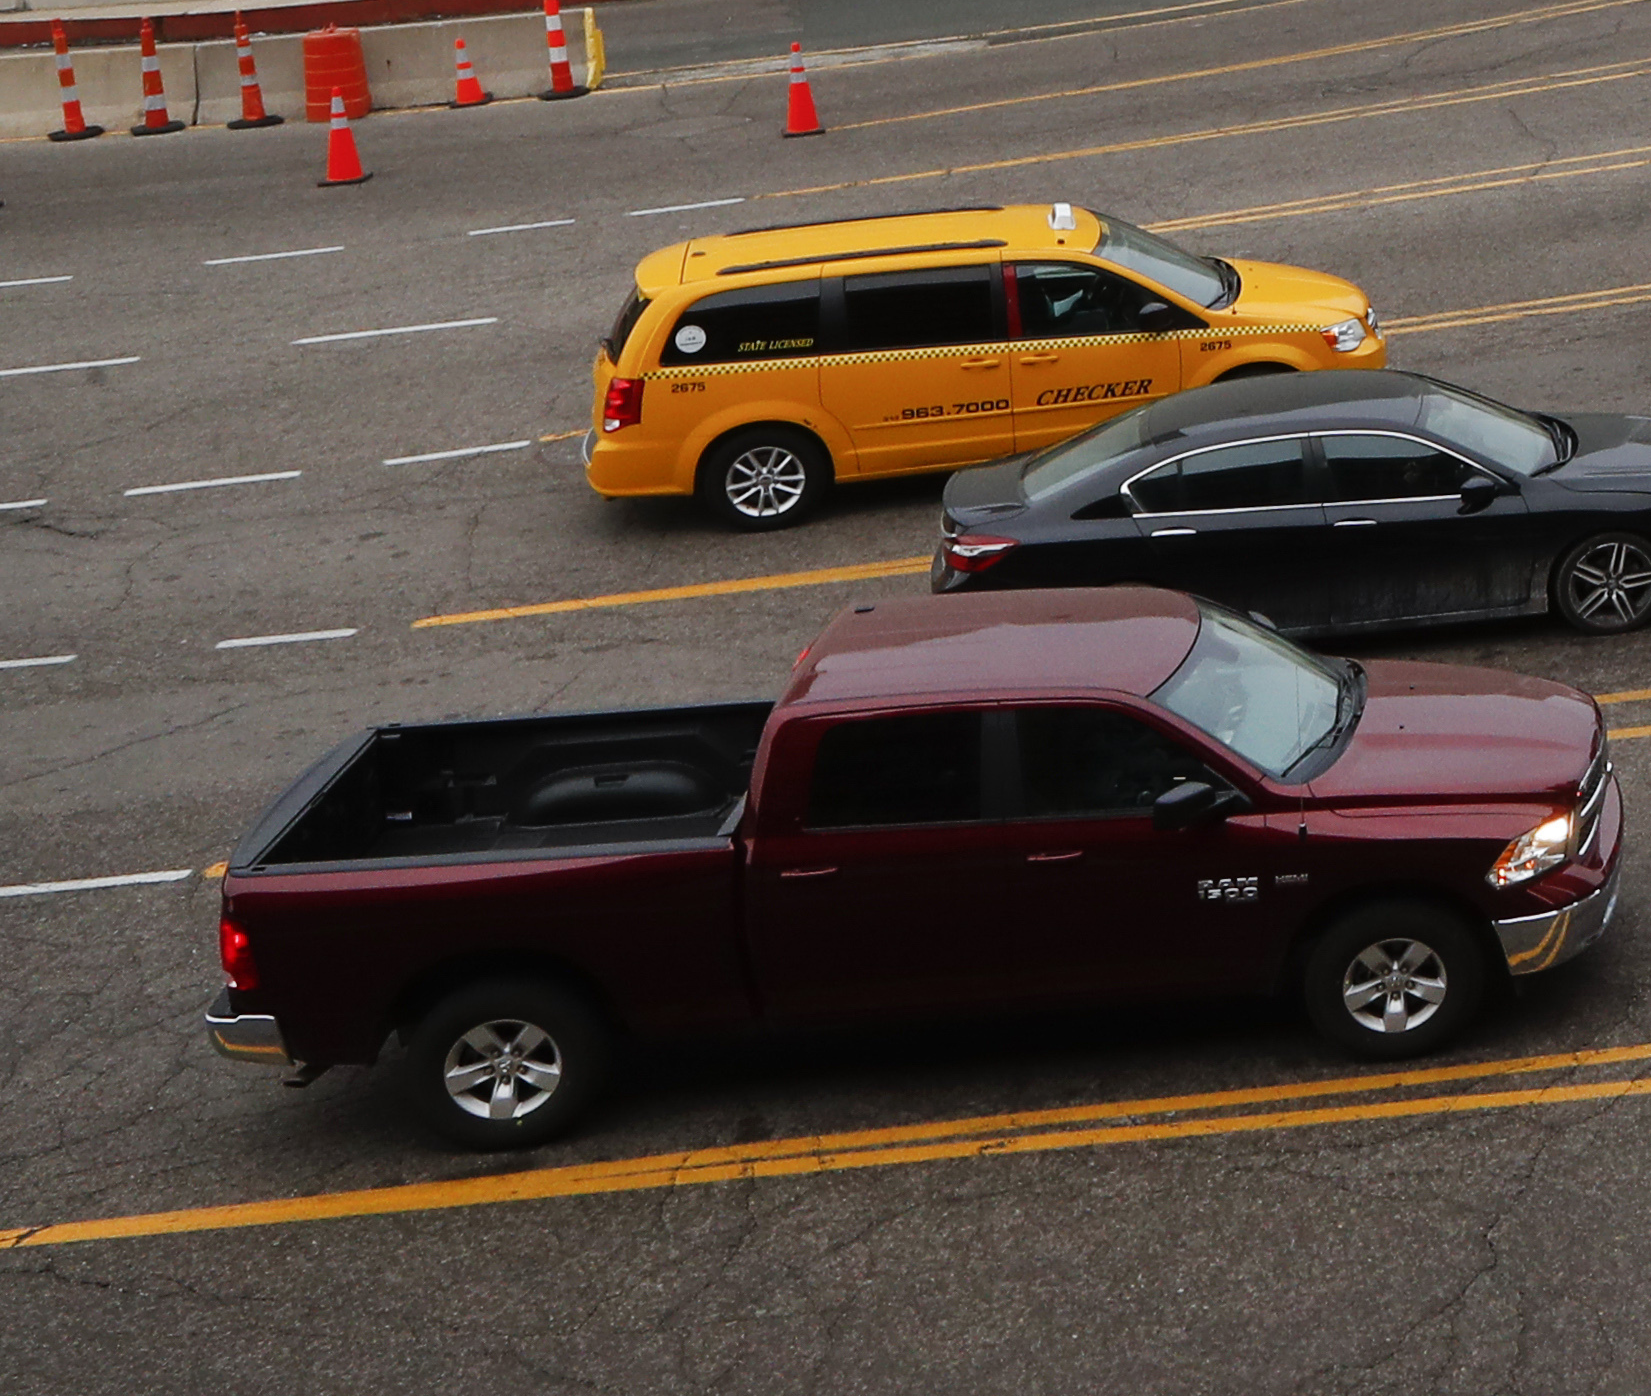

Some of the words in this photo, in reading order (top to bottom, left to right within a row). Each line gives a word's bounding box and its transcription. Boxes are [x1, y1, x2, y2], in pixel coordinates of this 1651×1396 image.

[738, 340, 766, 352] STATE
[769, 338, 814, 350] LICENSED
[1200, 340, 1232, 352] 2675
[671, 382, 706, 394] 2675
[1036, 378, 1153, 406] CHECKER
[902, 399, 1010, 420] 963.7000
[1198, 876, 1258, 888] RAM
[1198, 886, 1258, 902] 1500
